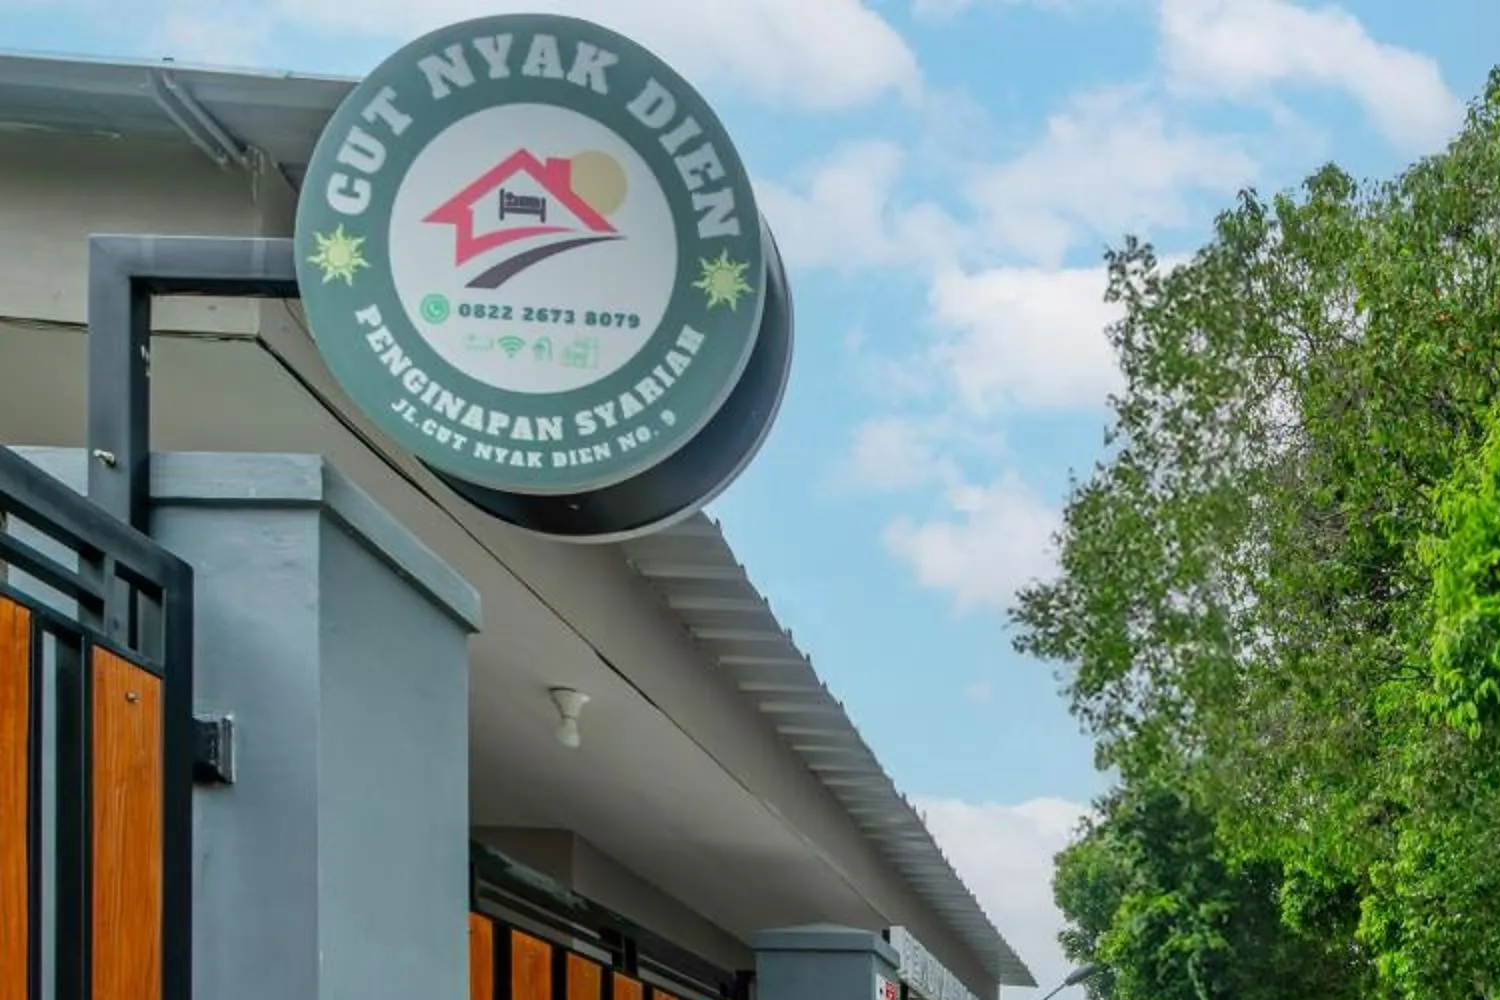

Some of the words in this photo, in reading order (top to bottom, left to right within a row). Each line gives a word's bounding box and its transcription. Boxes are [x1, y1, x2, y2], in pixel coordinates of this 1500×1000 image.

[327, 86, 414, 215] CUT
[416, 34, 620, 100] NYAK
[626, 76, 742, 240] DIEN
[459, 303, 514, 321] 0822
[523, 307, 576, 325] 2673
[584, 311, 642, 329] 8079
[355, 304, 564, 442] PENGINAPAN
[574, 323, 706, 426] SYARIAH
[473, 442, 543, 468] NYAK
[552, 442, 612, 468] DIEN
